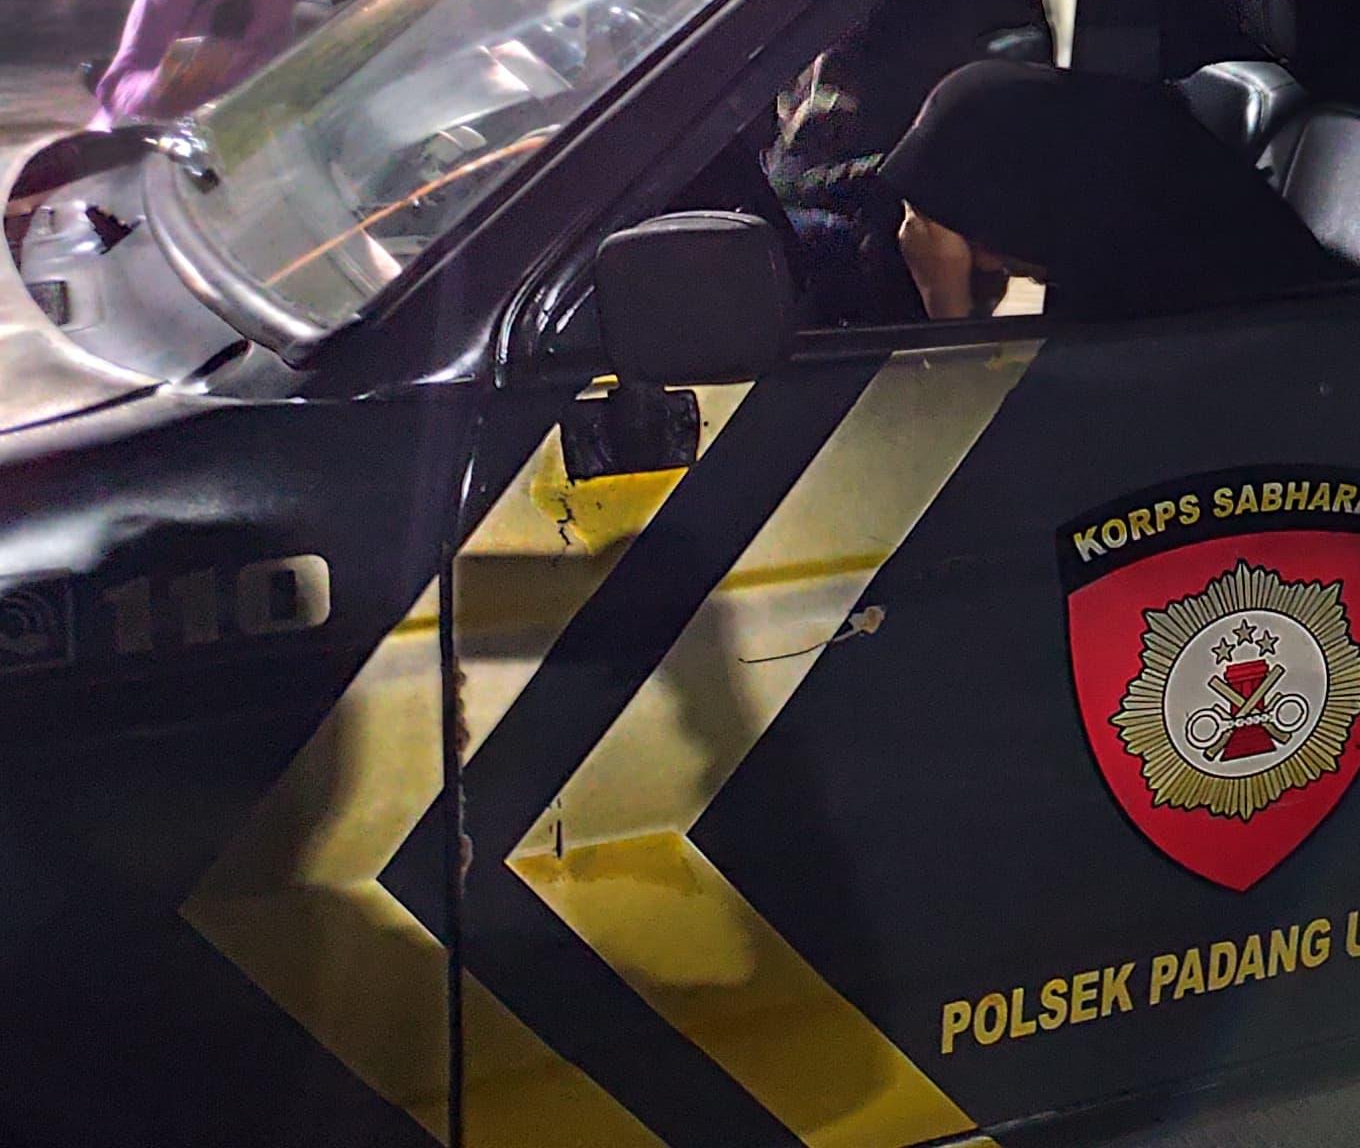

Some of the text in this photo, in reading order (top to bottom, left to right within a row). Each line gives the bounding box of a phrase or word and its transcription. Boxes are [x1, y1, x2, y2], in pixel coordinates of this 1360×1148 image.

[1073, 494, 1200, 563] KORPS
[98, 554, 330, 653] 110
[941, 956, 1136, 1053] POLSEK
[1150, 919, 1332, 1004] PADANG
